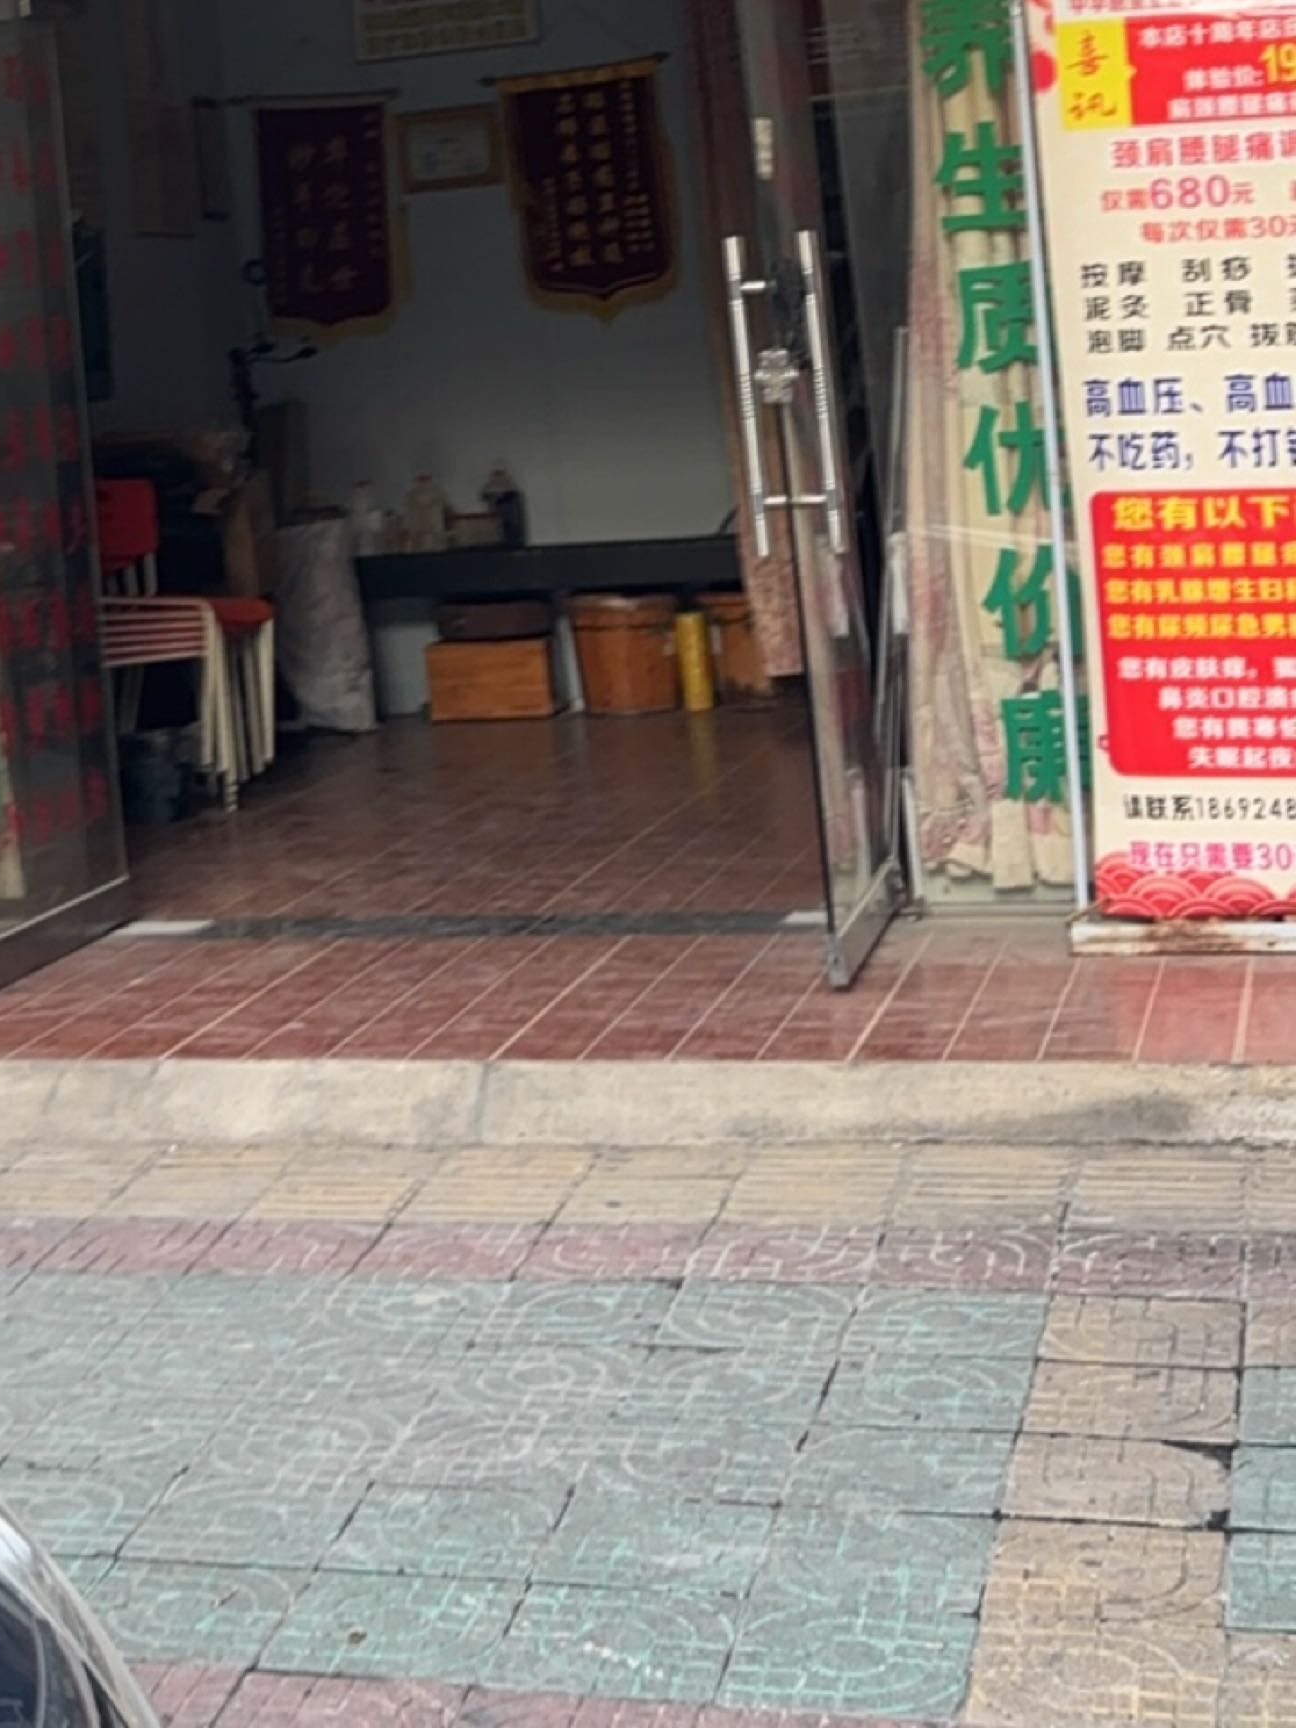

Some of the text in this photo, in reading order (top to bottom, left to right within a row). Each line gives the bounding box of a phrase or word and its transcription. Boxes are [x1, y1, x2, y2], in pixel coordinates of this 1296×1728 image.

[1101, 174, 1254, 212] 仅需680元
[1080, 256, 1251, 289] 按摩 刮痧
[1184, 290, 1252, 317] 正骨
[1167, 324, 1231, 352] 点穴
